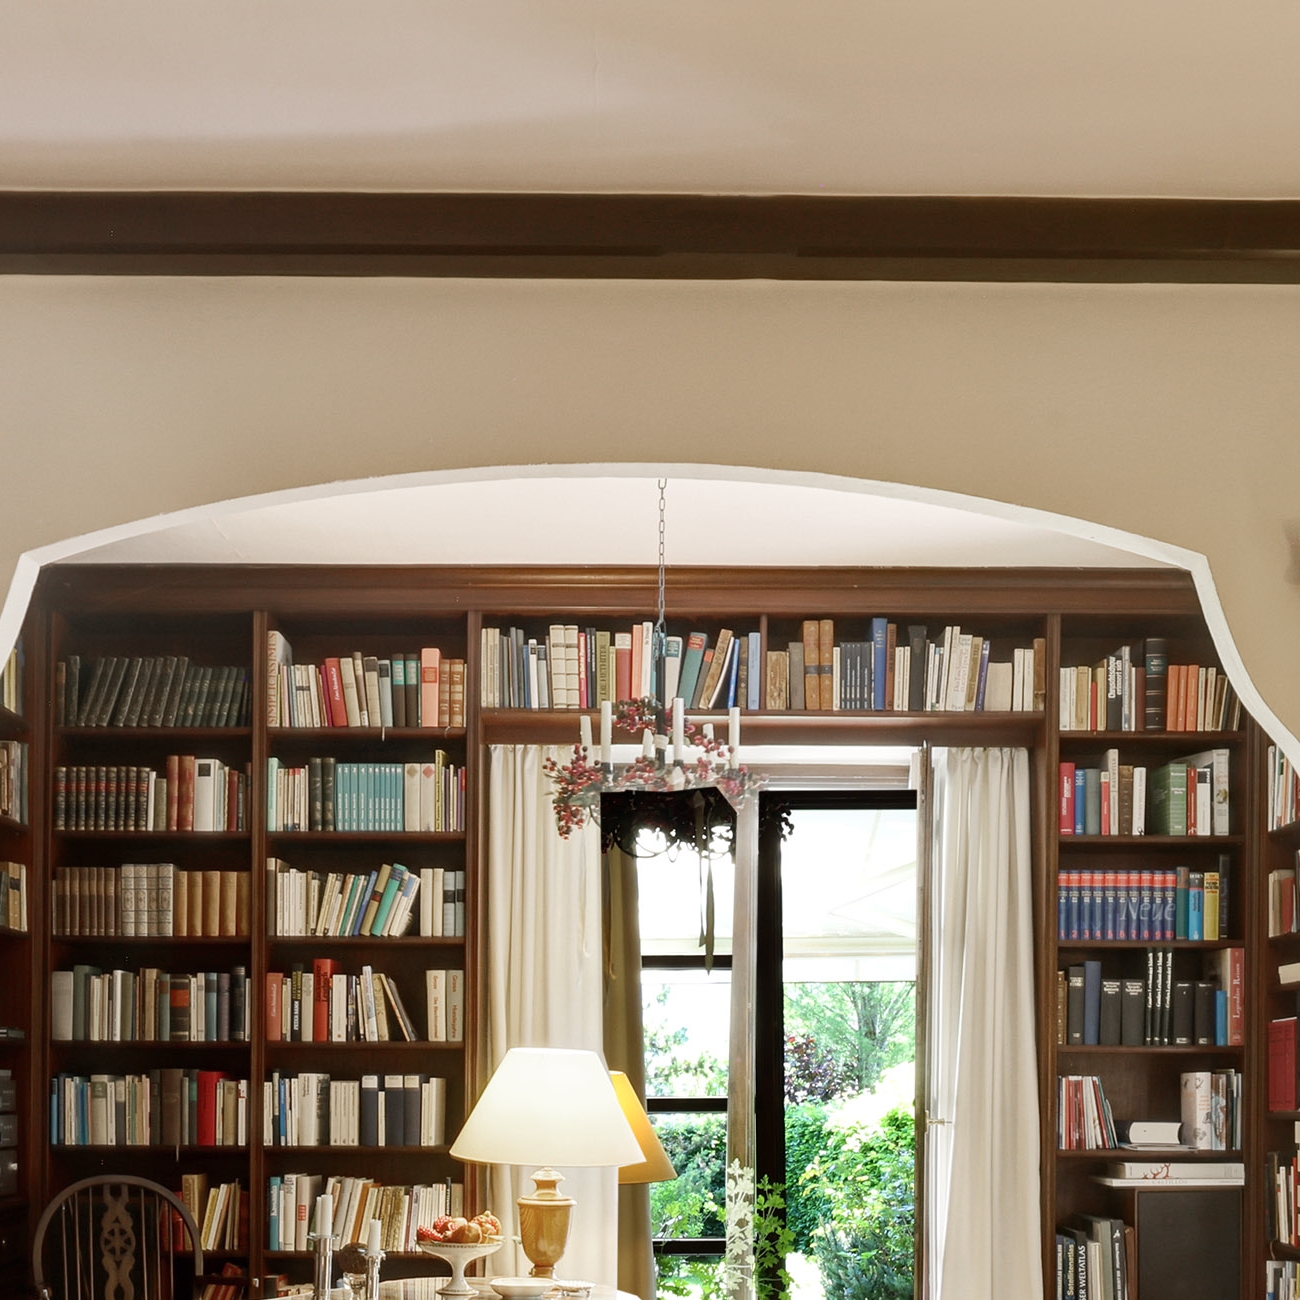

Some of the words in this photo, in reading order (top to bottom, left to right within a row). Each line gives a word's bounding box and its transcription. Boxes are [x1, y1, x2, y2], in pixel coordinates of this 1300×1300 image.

[267, 633, 277, 725] SIMPLICISSIMUS
[1120, 896, 1175, 921] Neue
[1072, 930, 1077, 938] 2
[1084, 930, 1089, 938] 3
[1095, 930, 1101, 938] 4
[1066, 1244, 1075, 1296] Satellitenatlas
[1077, 1245, 1087, 1288] WELTATLAS
